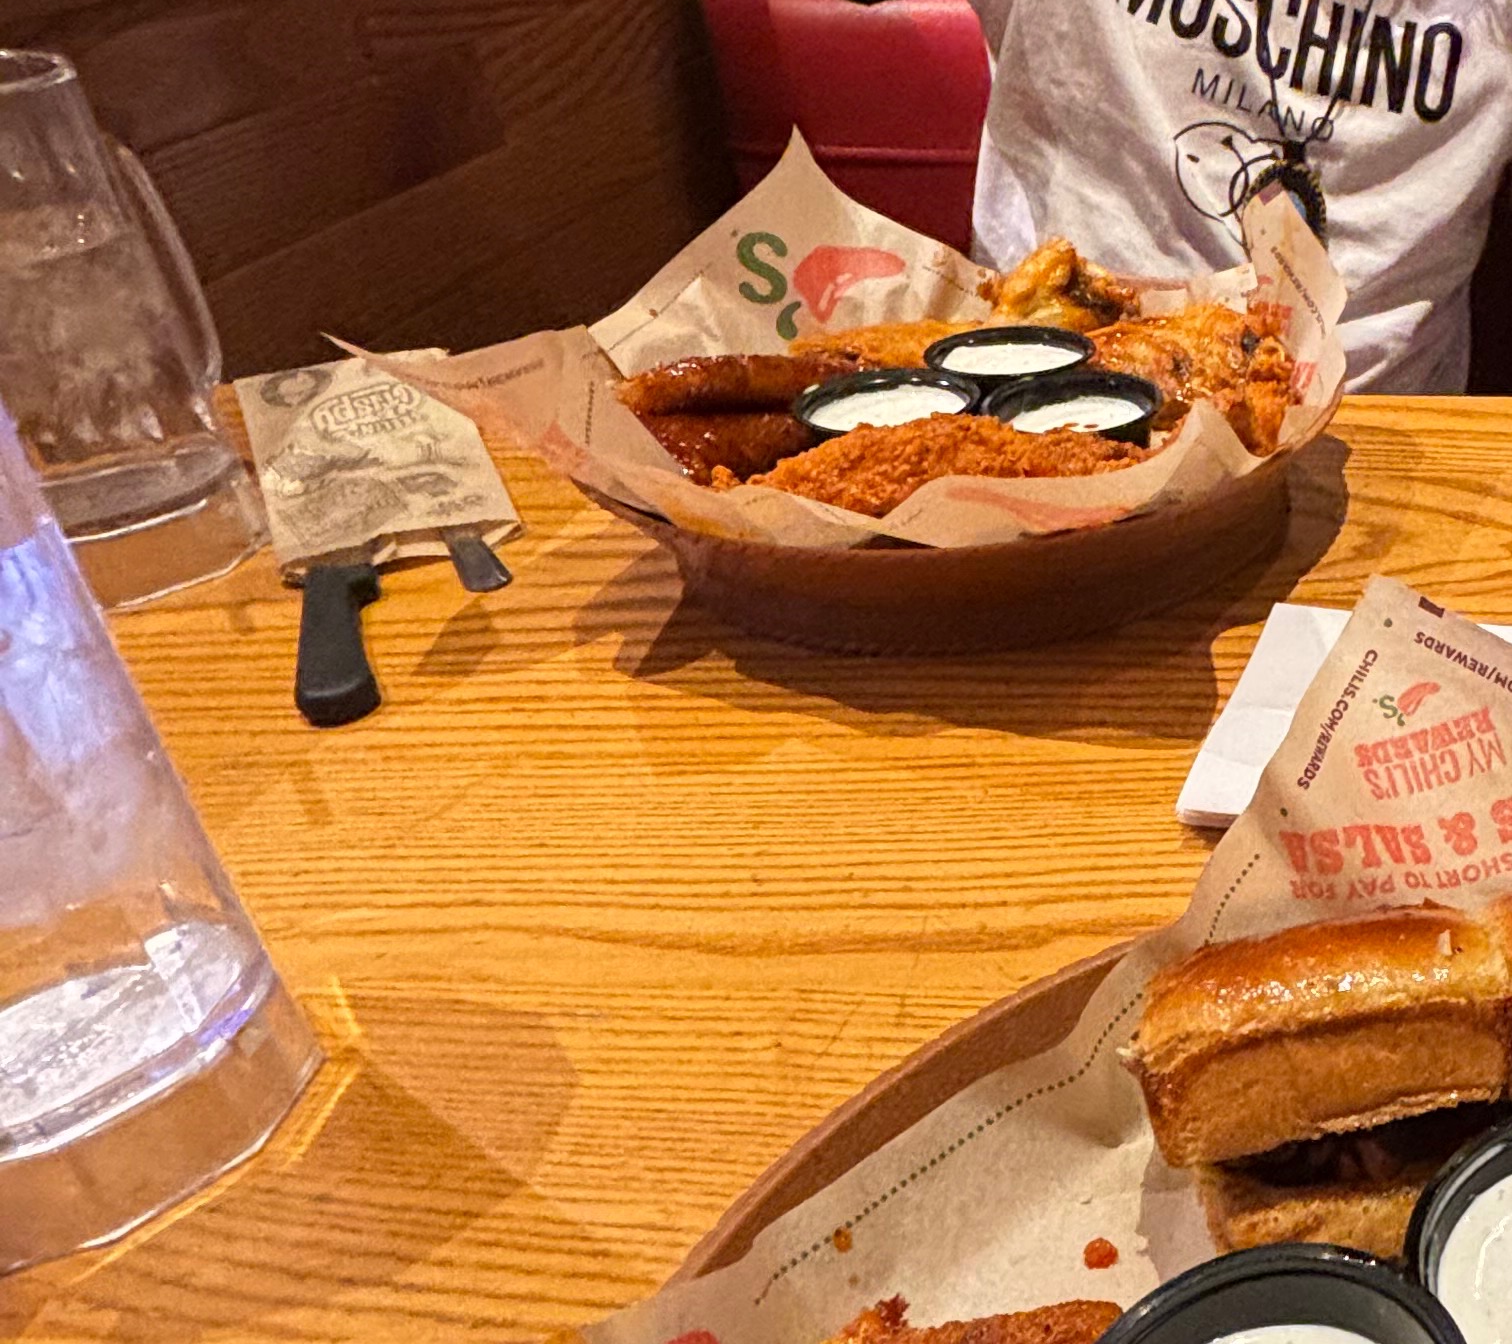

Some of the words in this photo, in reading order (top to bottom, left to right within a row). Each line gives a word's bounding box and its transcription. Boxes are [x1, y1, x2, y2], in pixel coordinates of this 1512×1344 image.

[1191, 67, 1335, 142] MILANO
[1296, 648, 1379, 791] CHILIS.COM/REWARDS
[1352, 705, 1498, 769] REWARDS
[1361, 750, 1462, 802] CHILI'S
[1465, 732, 1508, 779] MY
[1278, 823, 1433, 877] SALSA
[1436, 811, 1479, 857] &
[1288, 879, 1338, 902] FOR
[1346, 873, 1396, 902] PAY
[1404, 869, 1434, 892] TO
